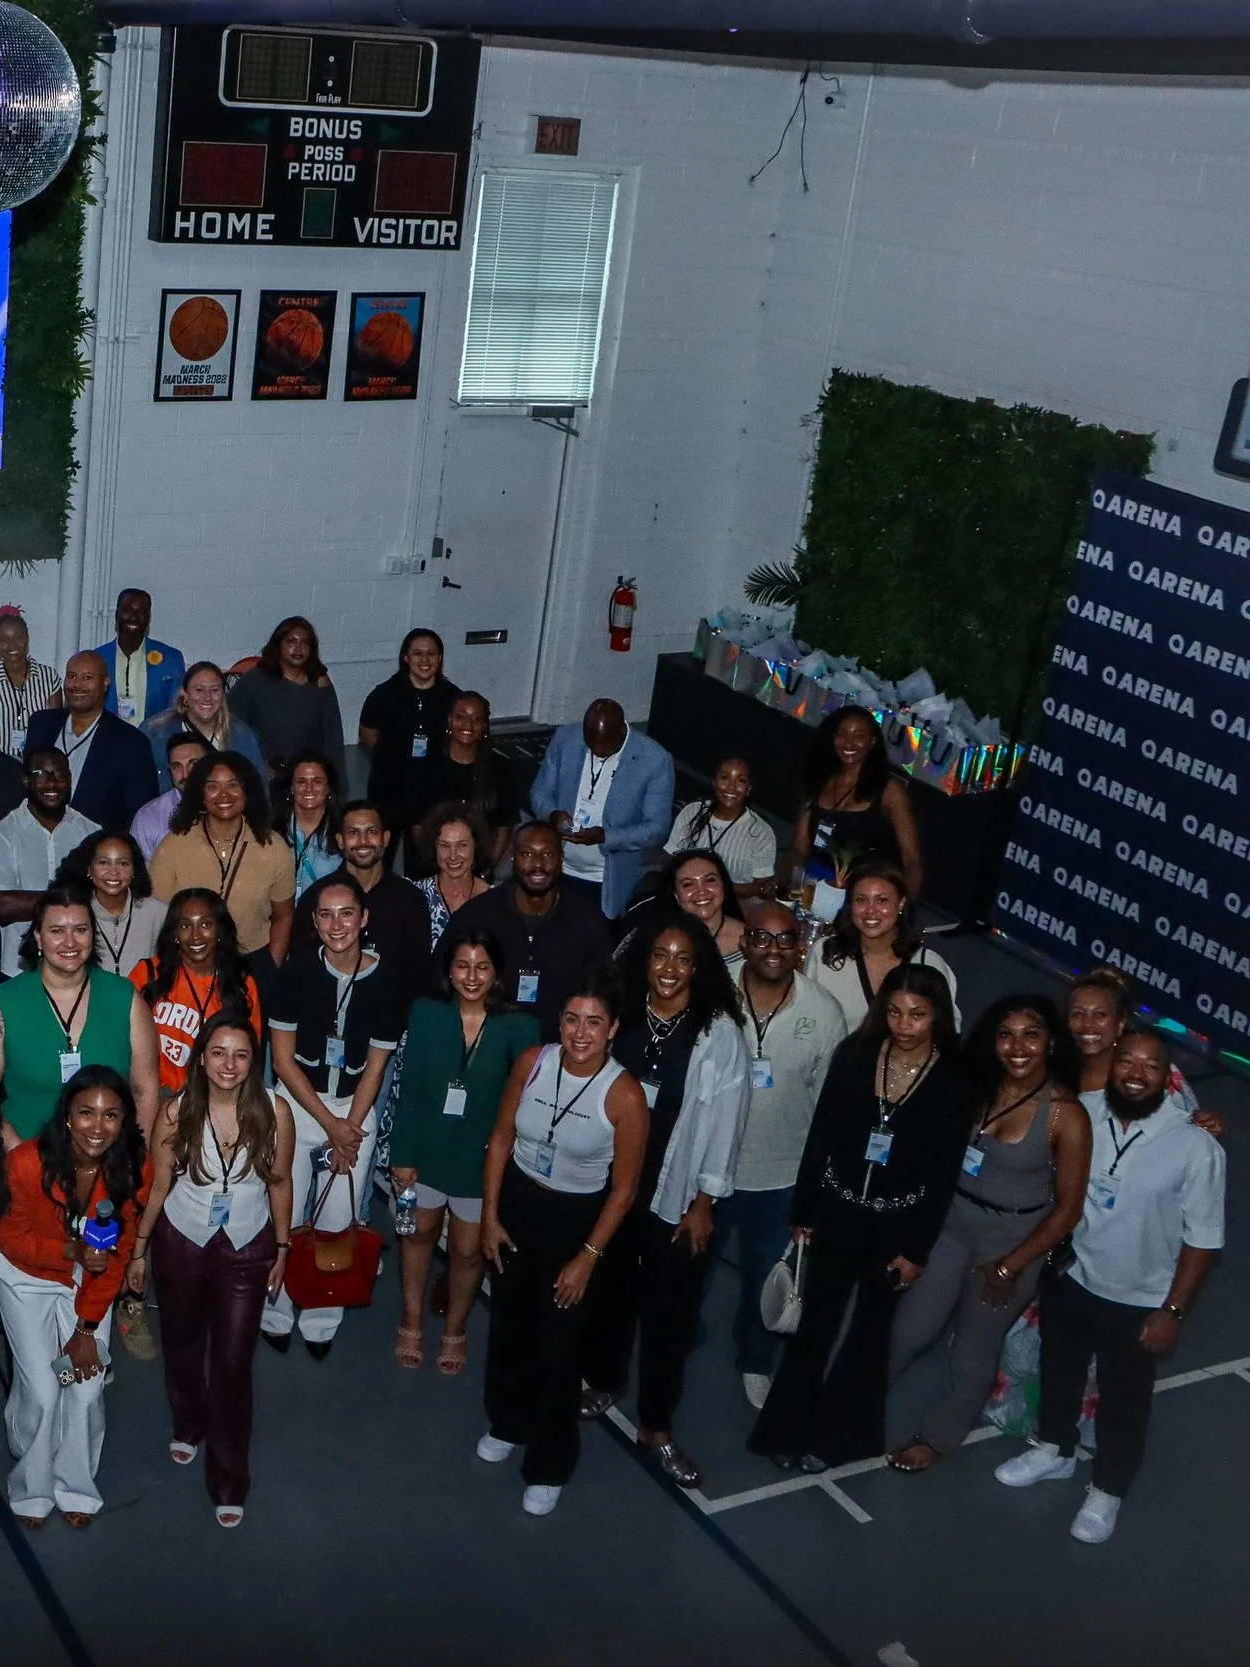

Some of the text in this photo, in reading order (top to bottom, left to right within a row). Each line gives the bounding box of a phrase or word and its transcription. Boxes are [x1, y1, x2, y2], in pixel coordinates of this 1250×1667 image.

[289, 118, 363, 140] BONUS
[539, 121, 575, 150] EXIT
[304, 145, 344, 161] POSS
[287, 163, 356, 183] PERIOD
[174, 212, 275, 240] HOME
[353, 217, 458, 246] VISITOR
[162, 374, 227, 384] MADNESS 2022
[180, 364, 211, 375] MARCH
[165, 1040, 183, 1062] 23
